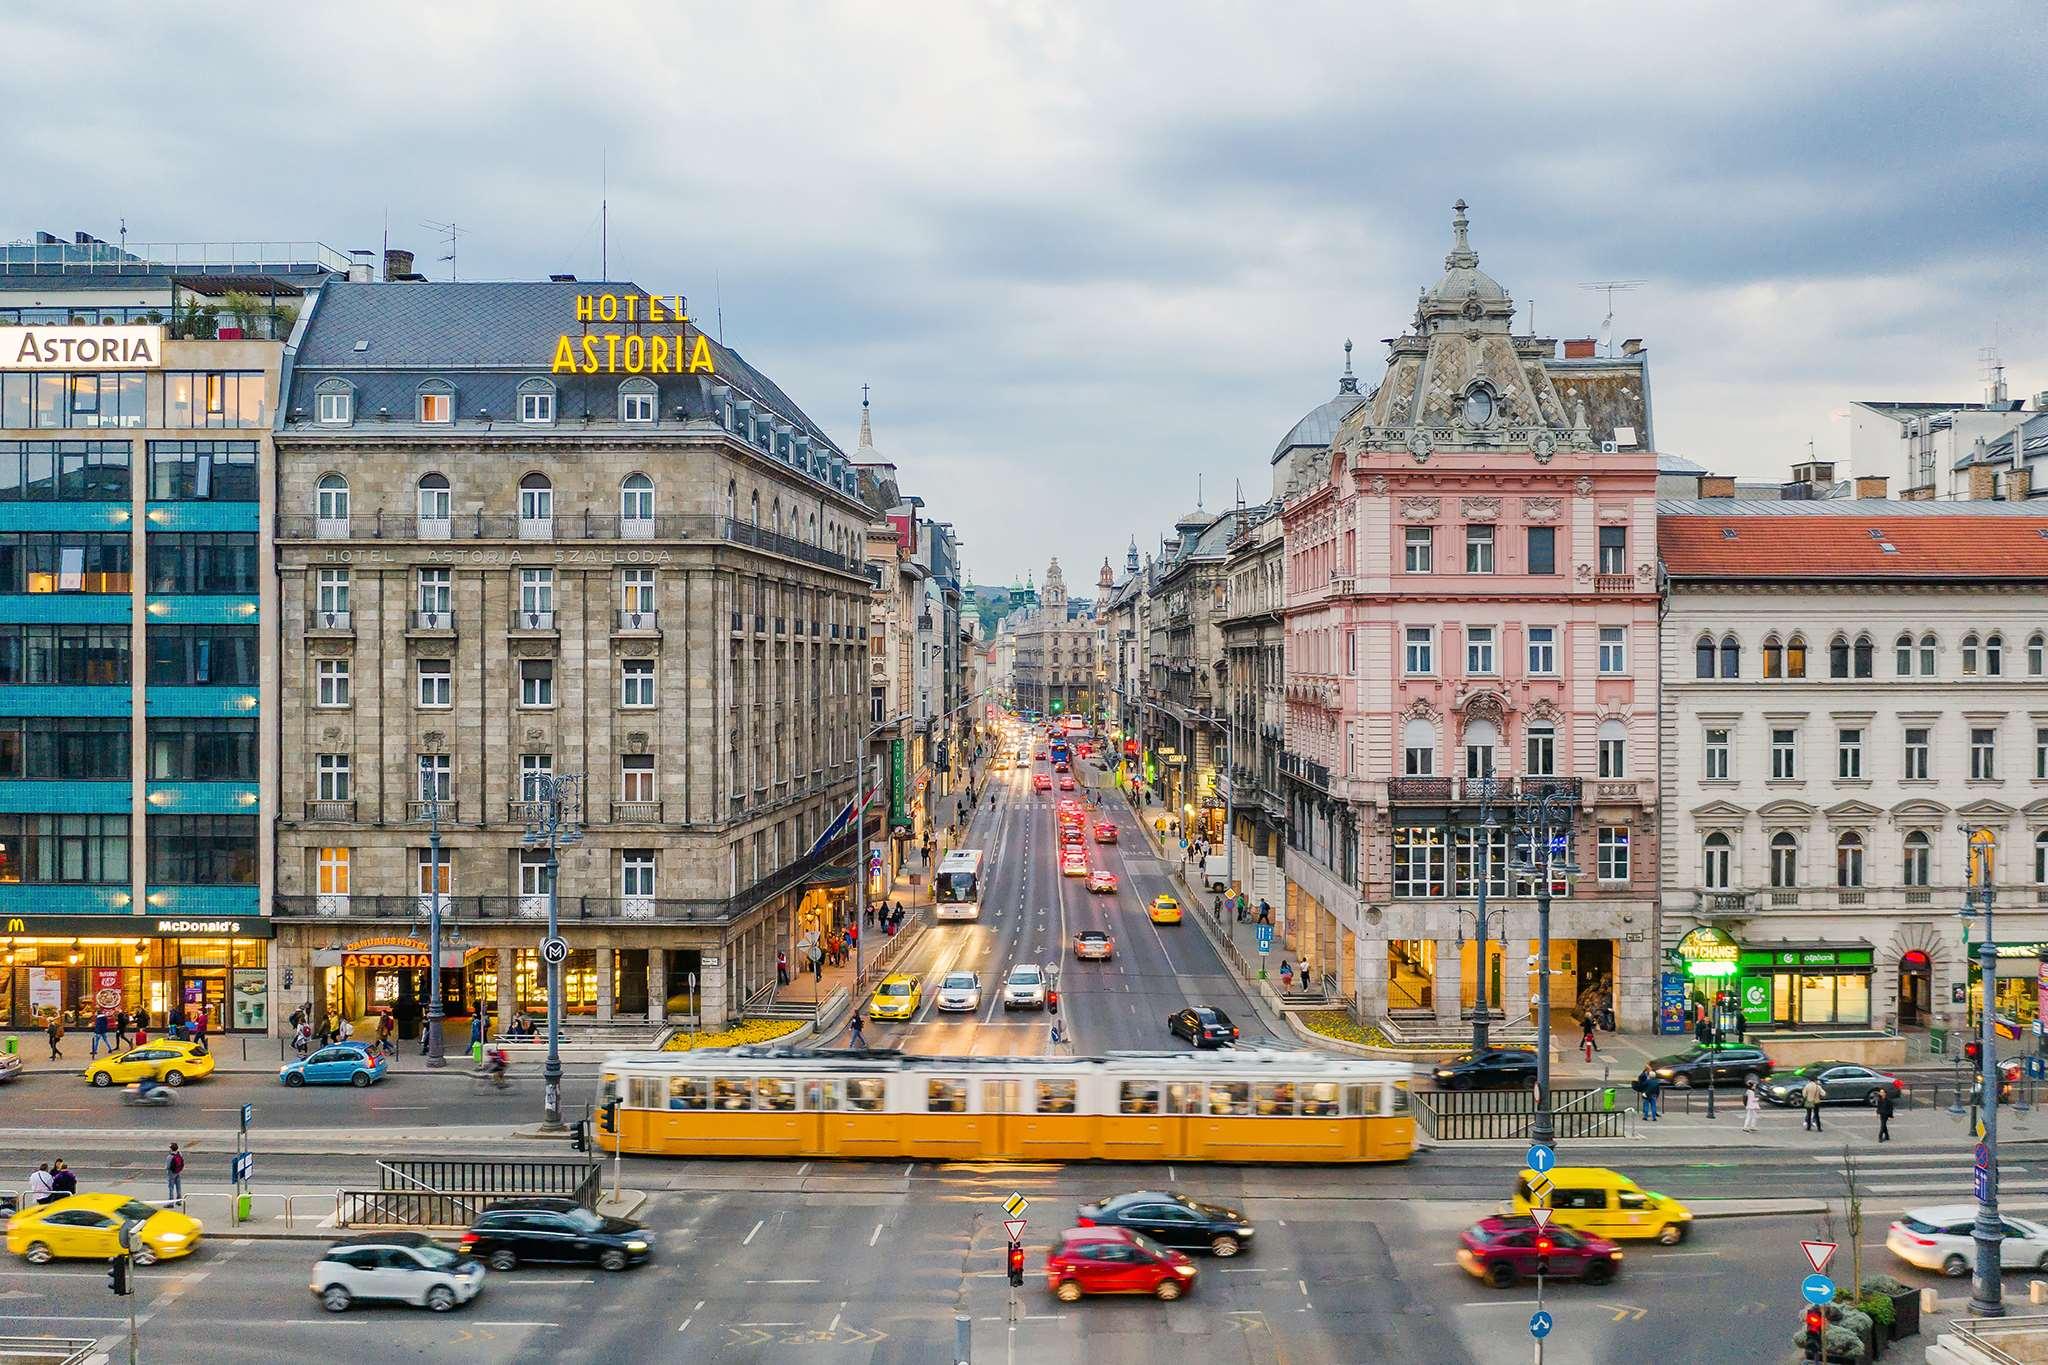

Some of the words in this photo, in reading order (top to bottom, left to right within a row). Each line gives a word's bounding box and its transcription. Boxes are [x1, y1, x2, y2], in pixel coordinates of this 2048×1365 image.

[576, 293, 689, 322] HOTEL
[552, 335, 716, 374] ASTORIA
[325, 550, 396, 563] HOTEL
[426, 550, 523, 563] ASTORIA
[158, 920, 240, 932] McDonald's
[1678, 945, 1699, 959] CITY
[1700, 945, 1738, 959] CHANGE
[345, 954, 431, 967] ASTORIA
